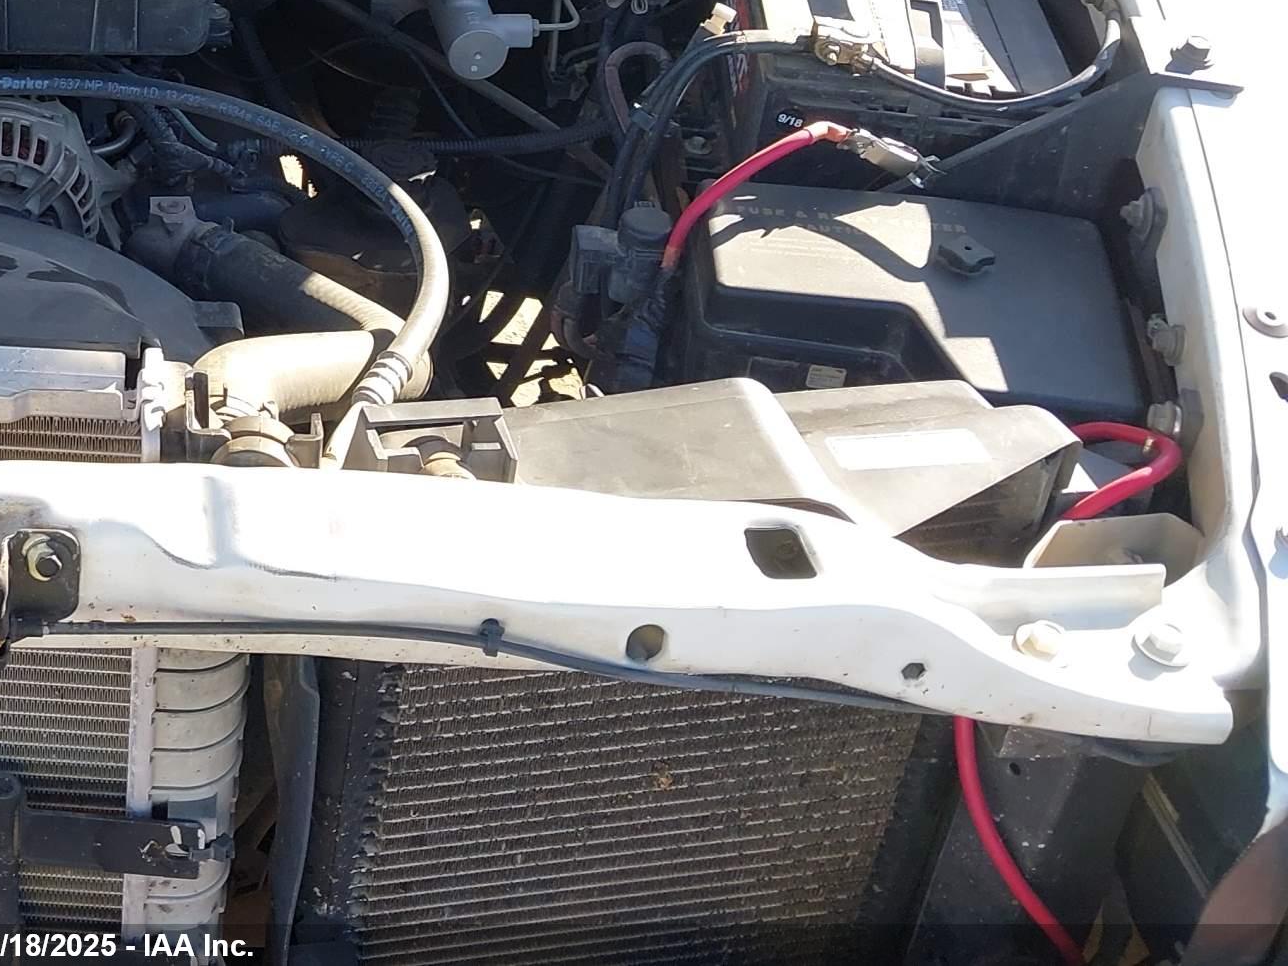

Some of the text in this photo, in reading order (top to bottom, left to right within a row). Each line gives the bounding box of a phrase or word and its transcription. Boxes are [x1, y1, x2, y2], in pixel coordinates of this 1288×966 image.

[0, 76, 49, 90] Parker
[254, 116, 281, 132] SAE
[777, 113, 804, 128] 9/18
[736, 205, 785, 216] FUSE
